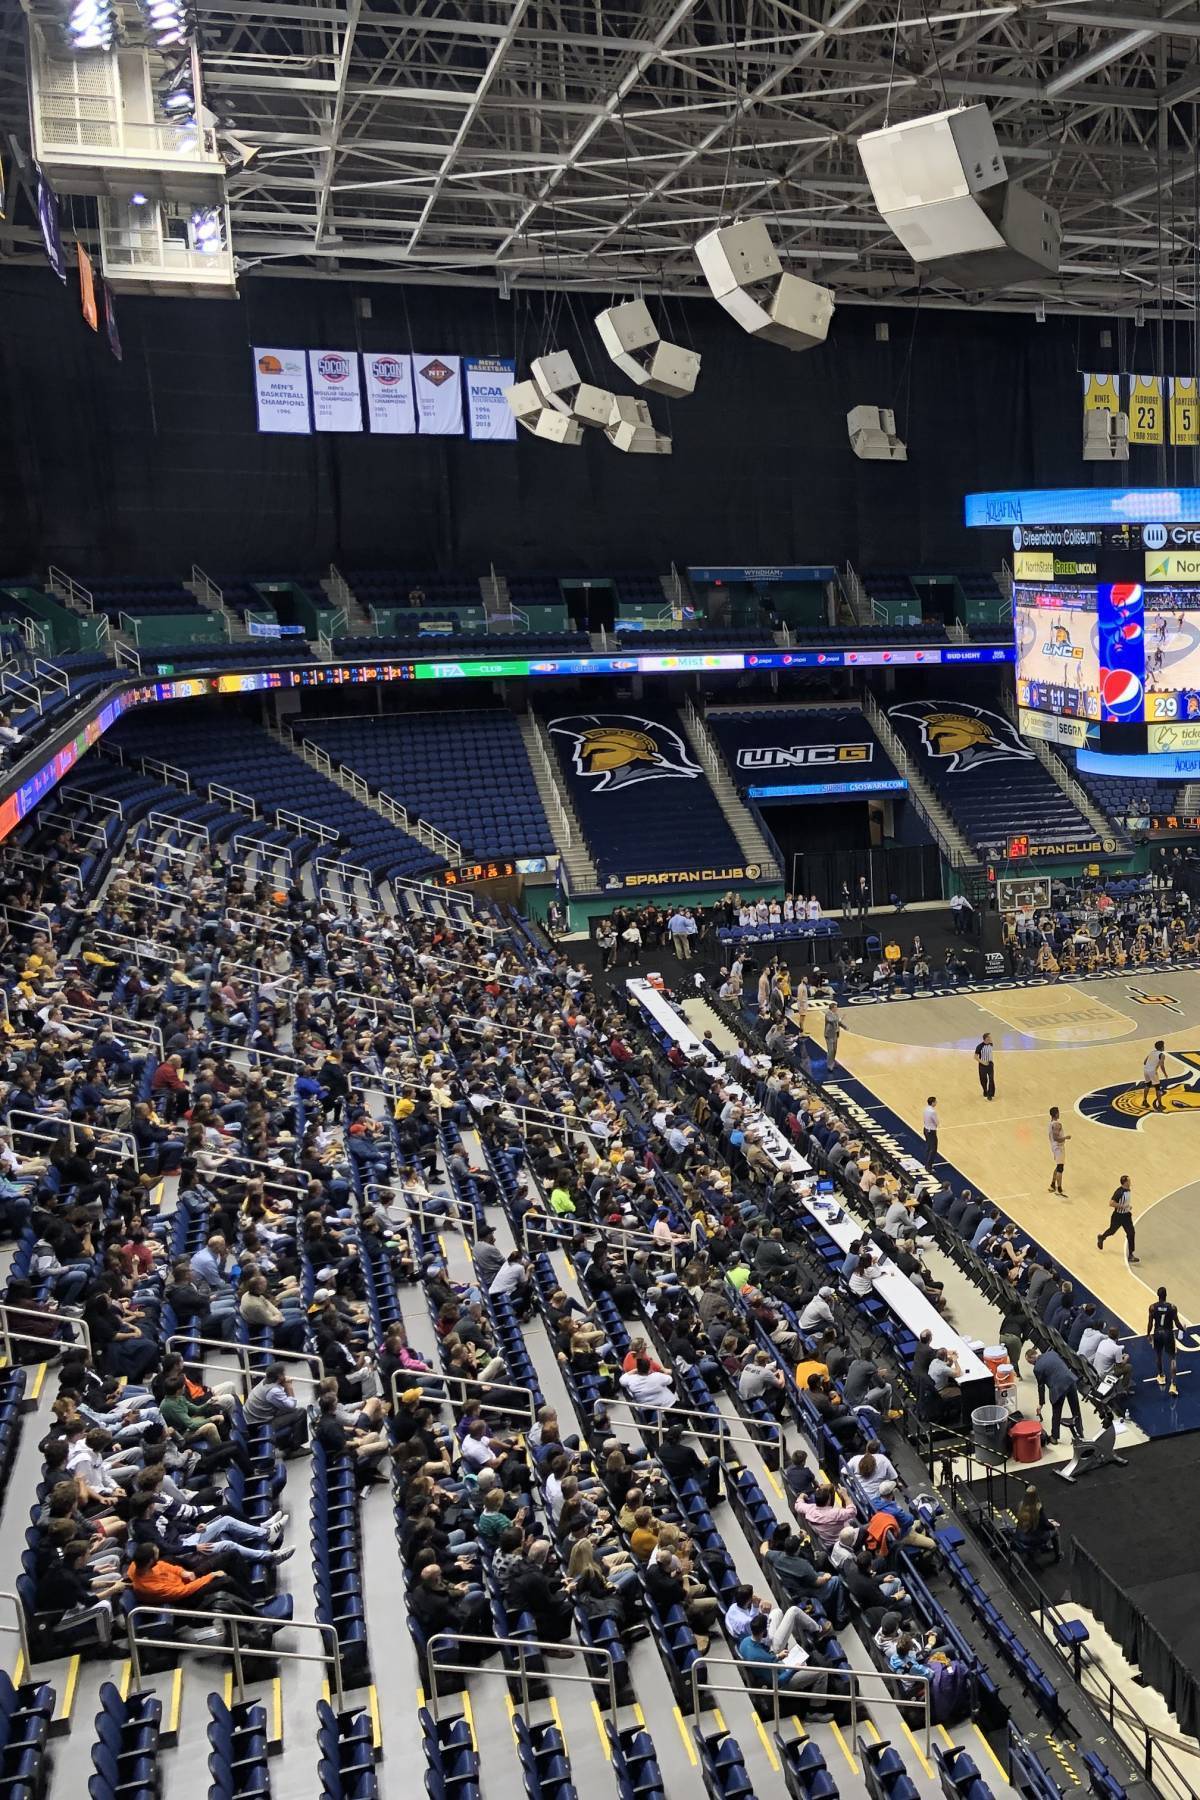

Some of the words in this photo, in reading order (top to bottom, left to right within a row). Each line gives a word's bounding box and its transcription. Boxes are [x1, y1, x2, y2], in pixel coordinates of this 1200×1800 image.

[318, 359, 349, 376] SOCON
[371, 362, 403, 378] SOCON
[468, 364, 512, 372] BASKETBALL
[270, 383, 294, 391] MEN'S
[471, 386, 503, 396] NCAA
[260, 390, 304, 399] BASKETBALL
[260, 398, 305, 407] CHAMPIONS
[1137, 406, 1156, 430] 23
[1182, 409, 1191, 431] 5
[1022, 529, 1062, 546] Greensboro
[1063, 528, 1097, 545] Coliseum
[1025, 560, 1053, 573] NorthState
[1054, 559, 1077, 575] GREEN
[1076, 563, 1097, 574] LINCOLN
[1042, 642, 1084, 660] UNCG
[678, 656, 704, 666] Mist
[343, 670, 350, 680] 2
[366, 669, 377, 678] 20
[431, 663, 466, 678] TFA
[479, 665, 503, 673] CLUB
[180, 682, 193, 698] 29
[240, 677, 256, 690] 26
[1021, 686, 1031, 703] 29
[1087, 697, 1098, 715] 26
[1153, 698, 1178, 717] 29
[739, 743, 873, 768] UNCG
[850, 781, 904, 792] GSOSWARM.COM
[1066, 842, 1101, 854] CLUB
[625, 870, 700, 888] SPARTAN
[701, 867, 744, 882] CLUB
[985, 952, 1005, 960] TFA
[848, 977, 1050, 1005] Greensboro
[1160, 1313, 1166, 1326] 1
